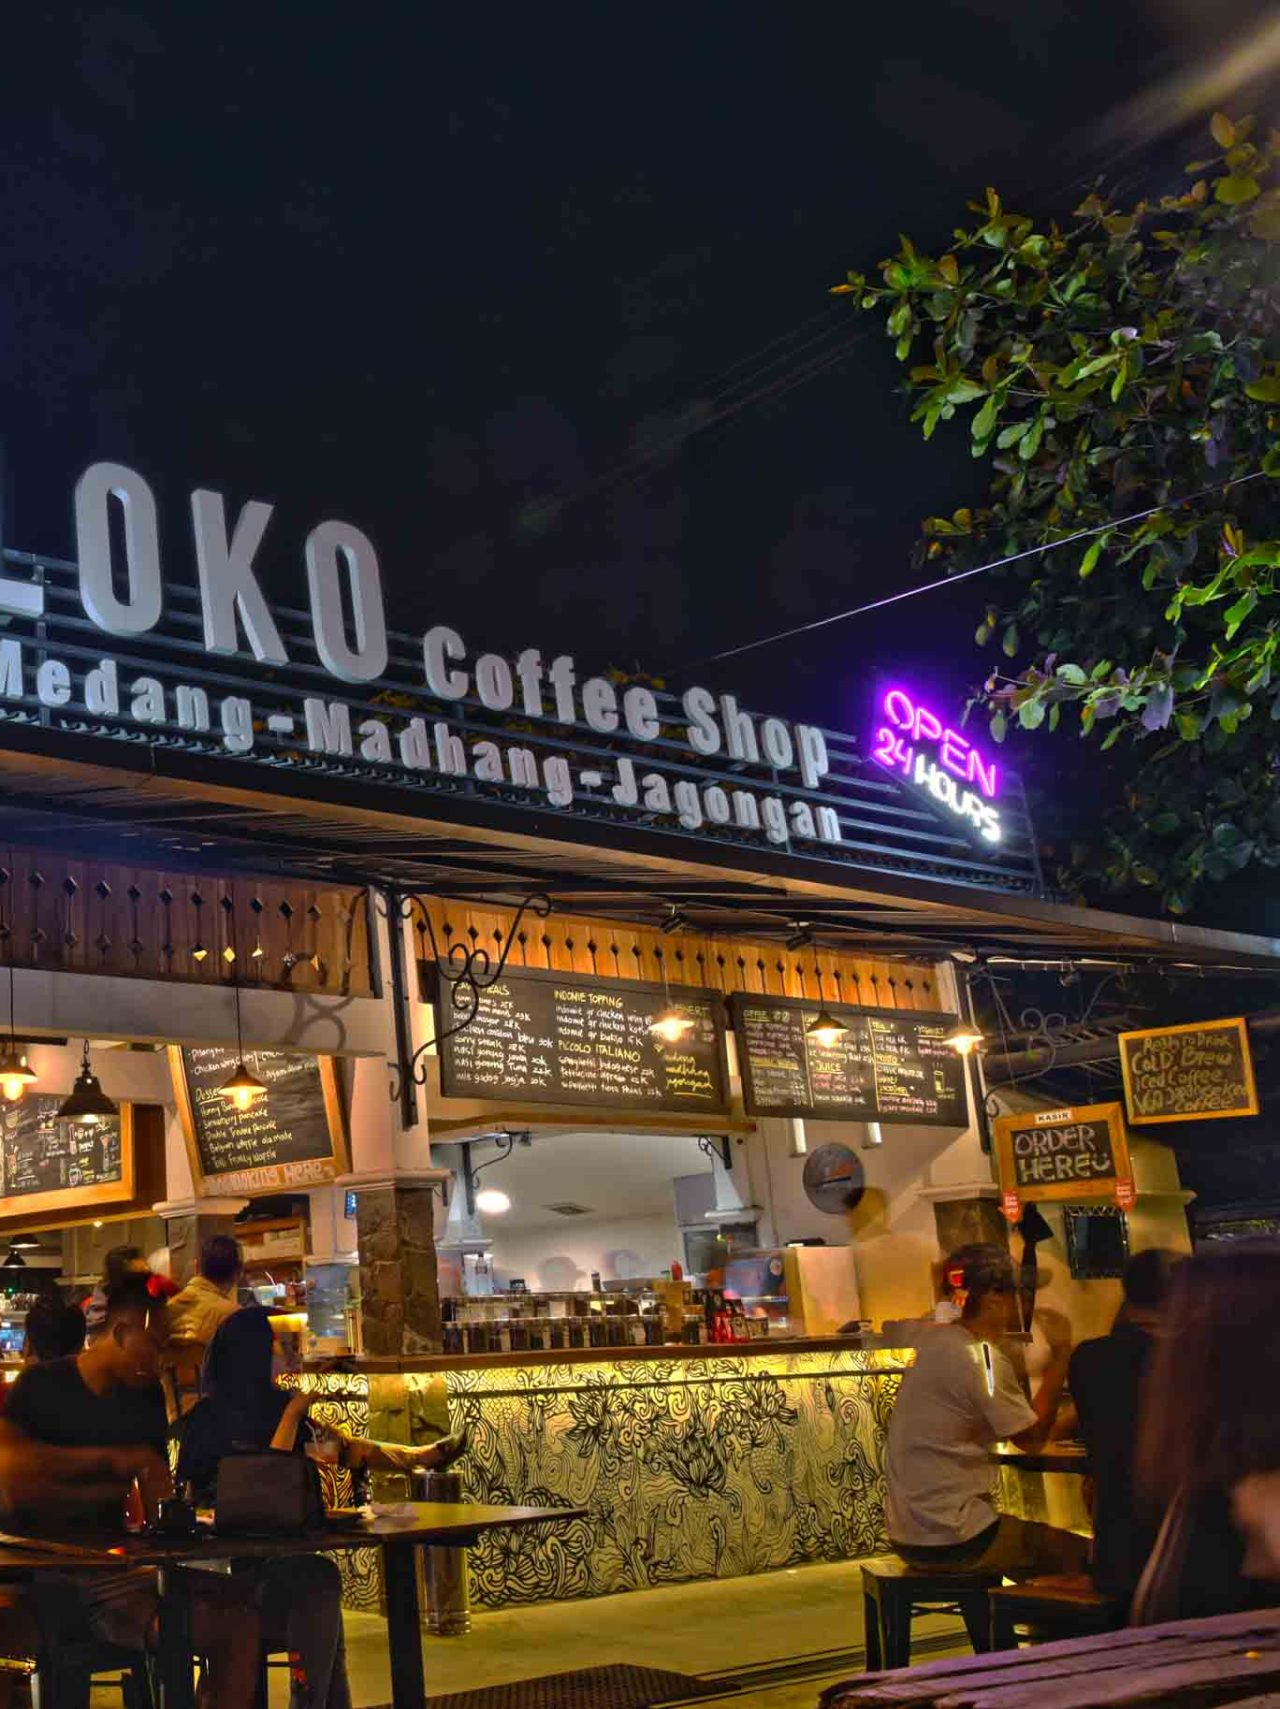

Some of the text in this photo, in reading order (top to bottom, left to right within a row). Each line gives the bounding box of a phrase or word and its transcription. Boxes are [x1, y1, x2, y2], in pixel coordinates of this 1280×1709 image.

[423, 625, 661, 742] Coffee
[683, 685, 828, 789] Shop
[885, 690, 996, 797] OPEN
[873, 728, 1001, 842] 24 HOURS
[587, 993, 623, 1008] TOPPING
[596, 1044, 641, 1062] ITALIANO
[1015, 1125, 1095, 1154] ORDER
[1018, 1152, 1091, 1182] HERE
